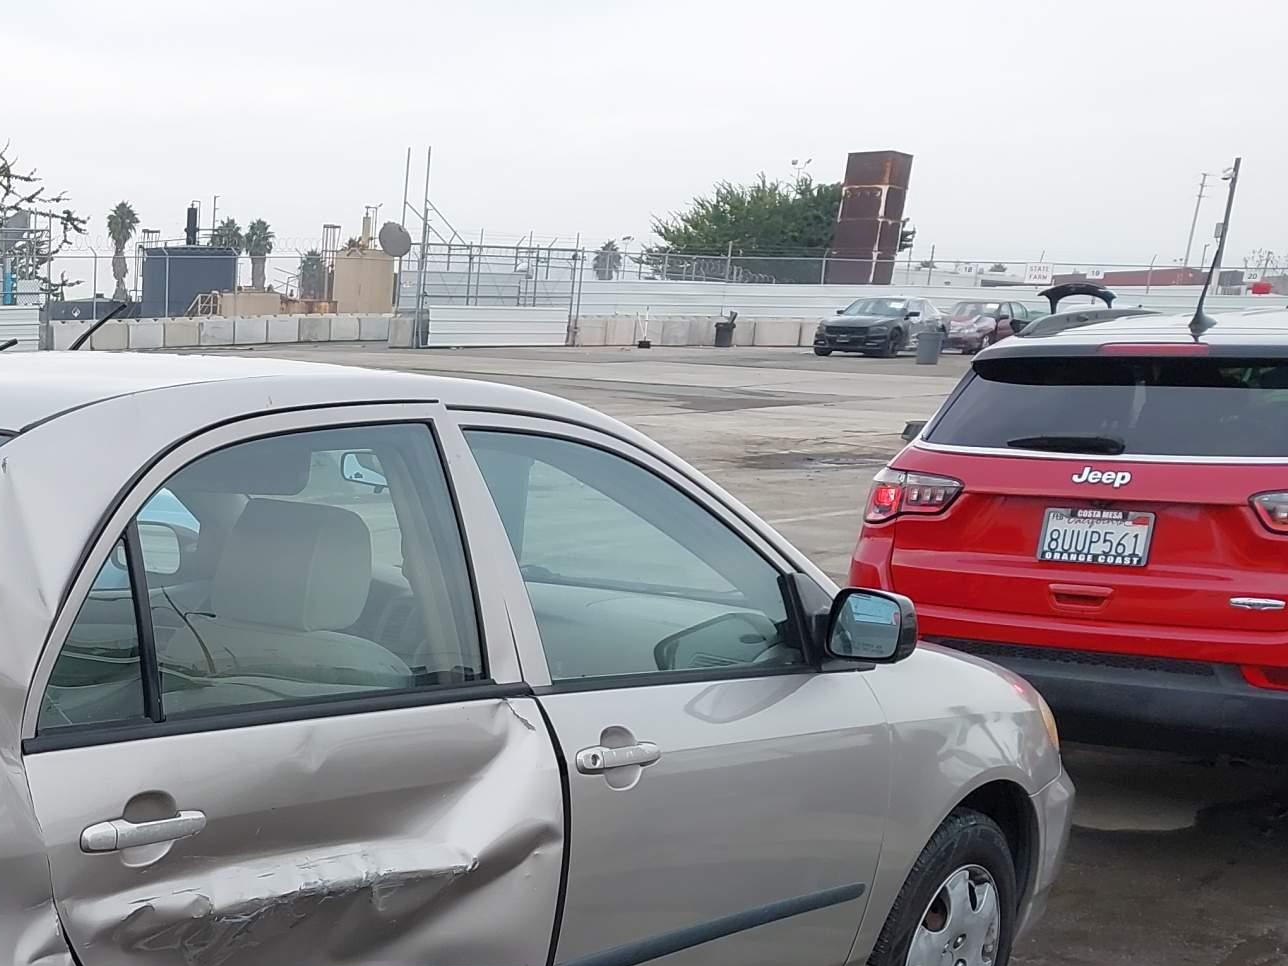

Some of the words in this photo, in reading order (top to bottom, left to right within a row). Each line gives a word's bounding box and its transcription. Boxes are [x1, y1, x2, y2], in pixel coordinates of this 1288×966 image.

[1072, 466, 1132, 488] Jeep
[1077, 509, 1101, 518] COSTA
[1102, 510, 1123, 520] MESA
[1048, 528, 1140, 557] 8UUP561
[1045, 551, 1093, 562] ORANGE
[1097, 555, 1140, 565] COAST
